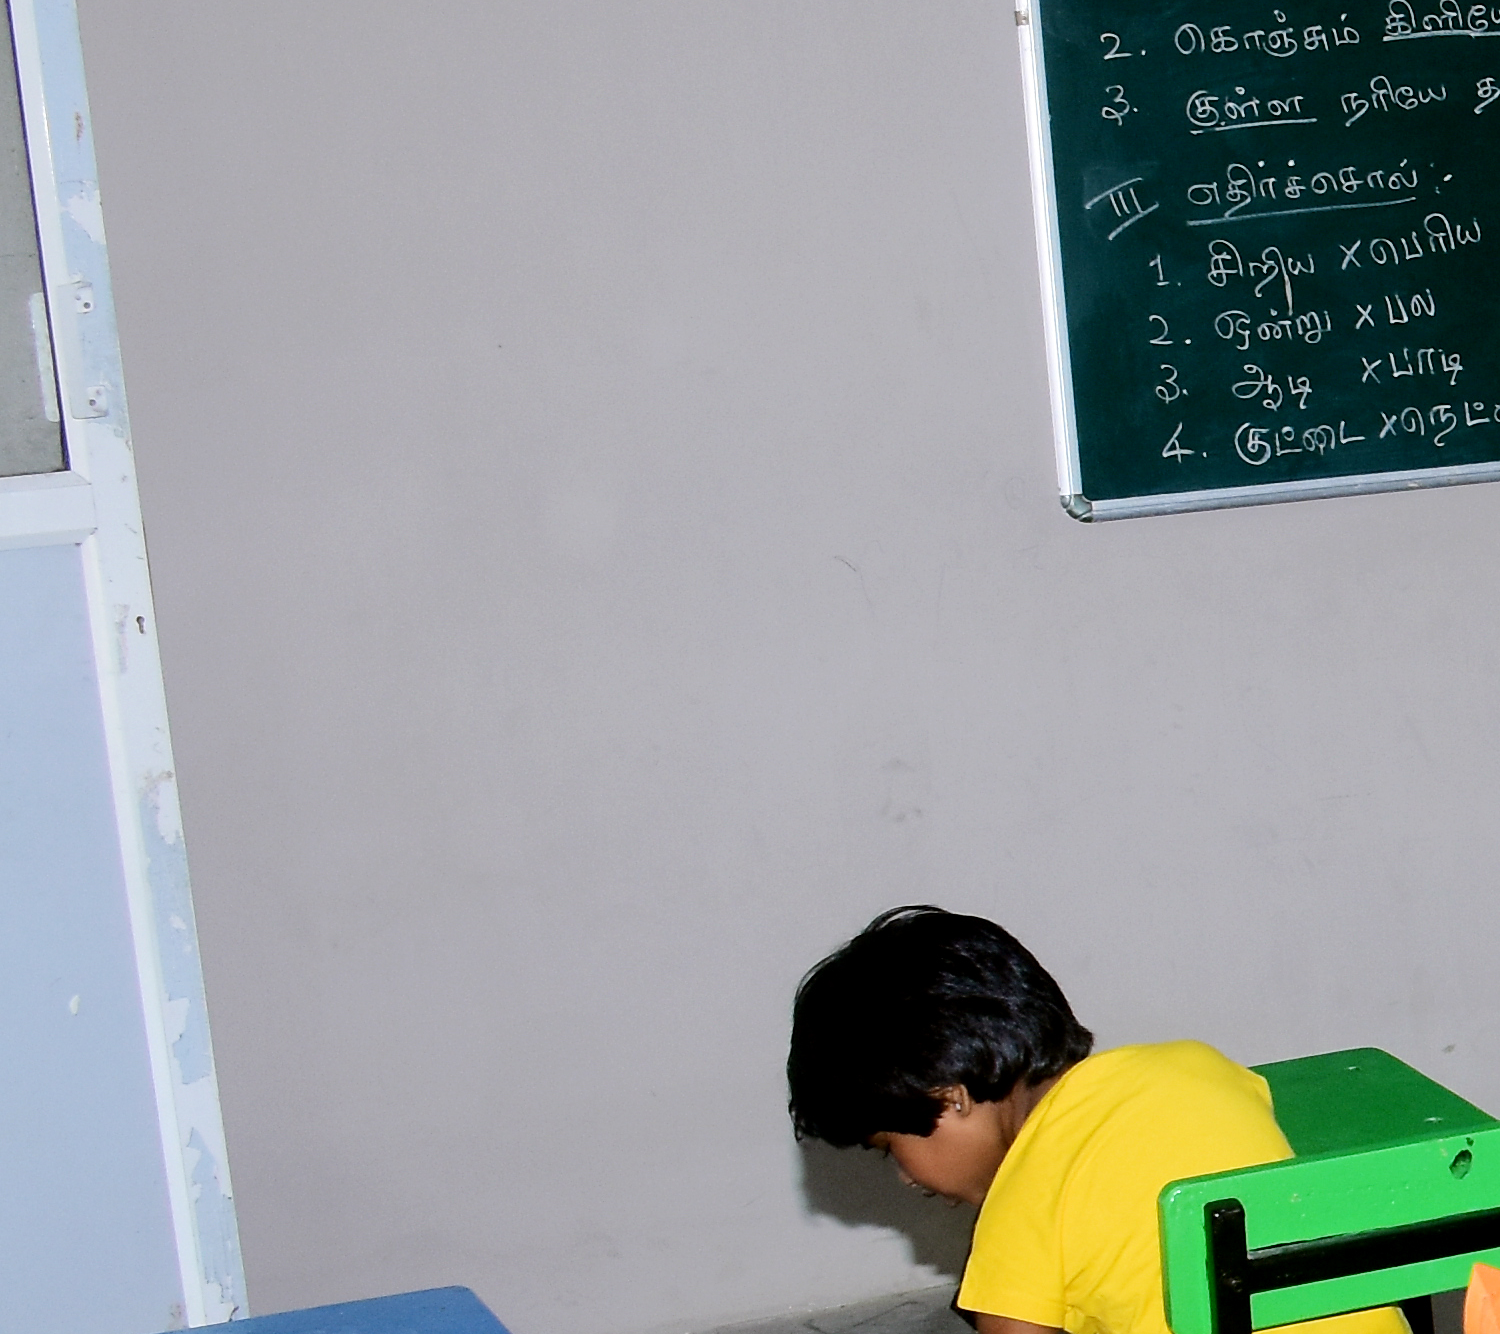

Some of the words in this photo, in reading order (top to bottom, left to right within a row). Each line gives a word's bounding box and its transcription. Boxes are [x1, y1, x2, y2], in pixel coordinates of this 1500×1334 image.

[1174, 9, 1360, 57] கொஞ்சும்
[1186, 86, 1308, 130] குள்ள
[1341, 75, 1447, 127] நரியே
[1207, 240, 1315, 299] சிறிய
[1369, 213, 1482, 265] பெரிய
[1215, 310, 1331, 349] ஒன்று
[1386, 289, 1436, 325] பல
[1232, 364, 1312, 411] ஆடி
[1393, 347, 1463, 385] பாடி
[1235, 421, 1365, 465] குட்டை
